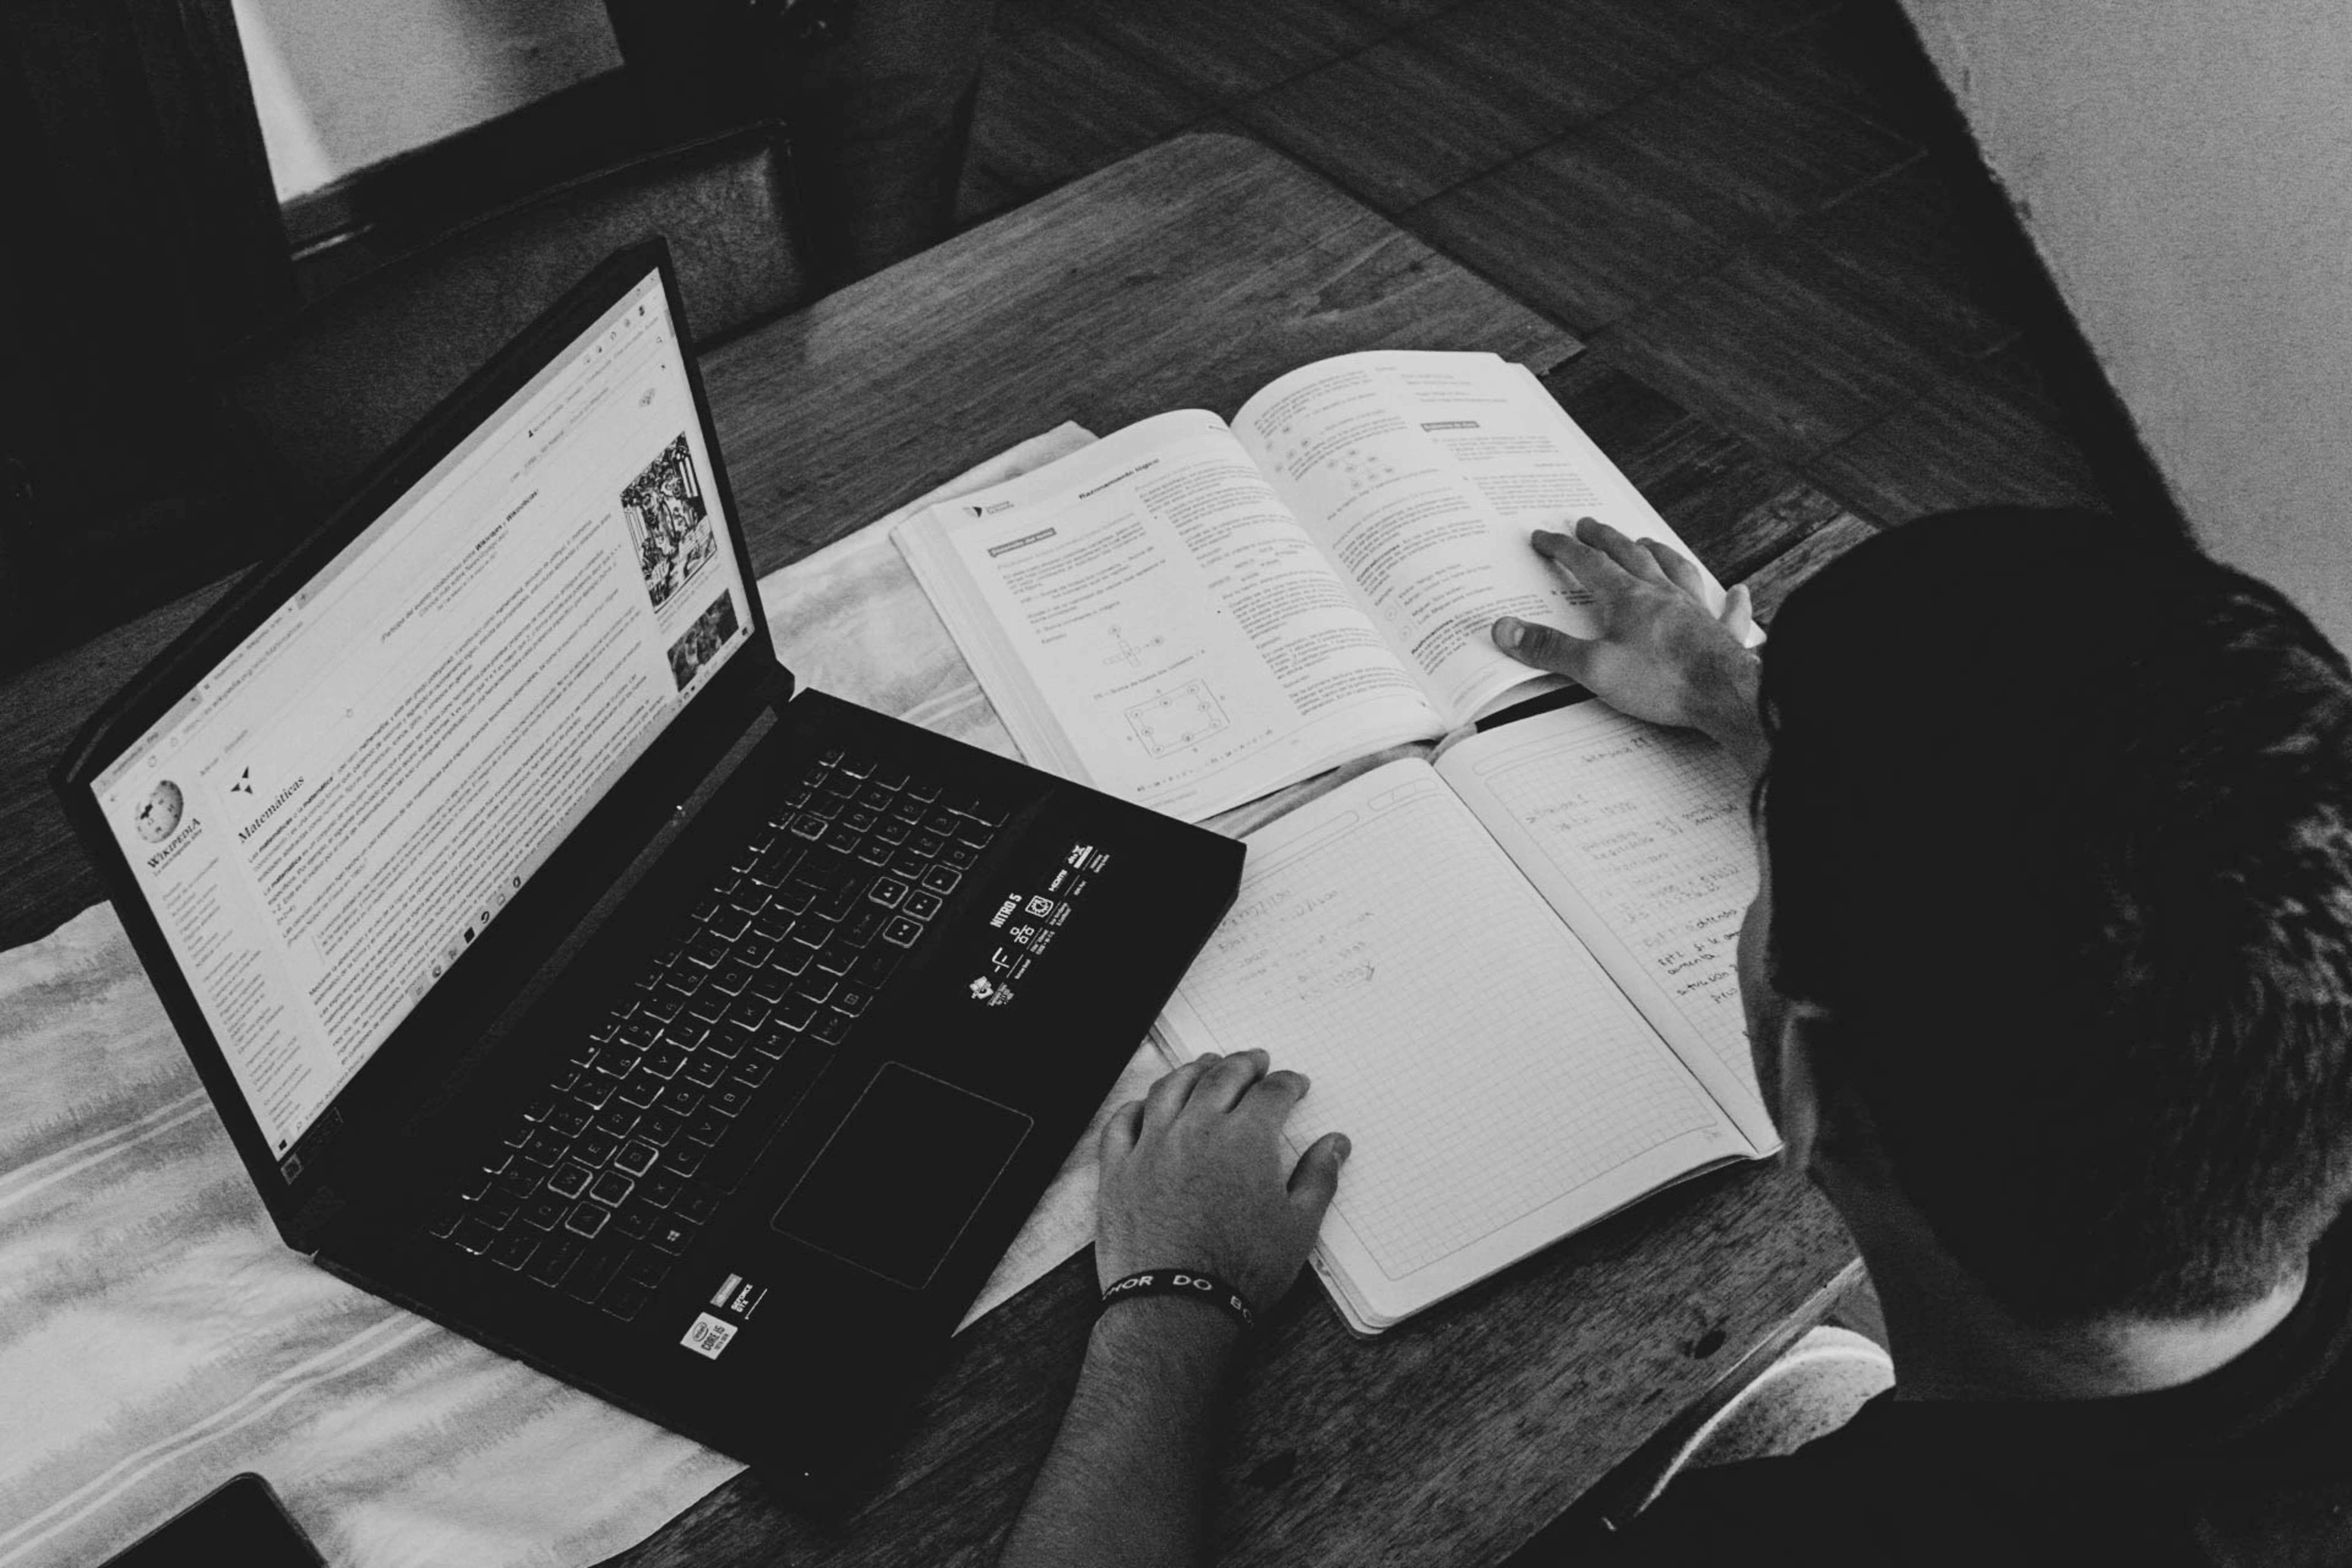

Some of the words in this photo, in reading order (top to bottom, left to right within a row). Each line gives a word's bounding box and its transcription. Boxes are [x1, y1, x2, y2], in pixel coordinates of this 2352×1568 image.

[239, 779, 303, 842] Matemáticas
[991, 901, 1016, 927] NITRO
[1009, 893, 1022, 902] 5
[1172, 1274, 1213, 1291] DO
[701, 1333, 719, 1350] CORE
[713, 1325, 724, 1334] i5
